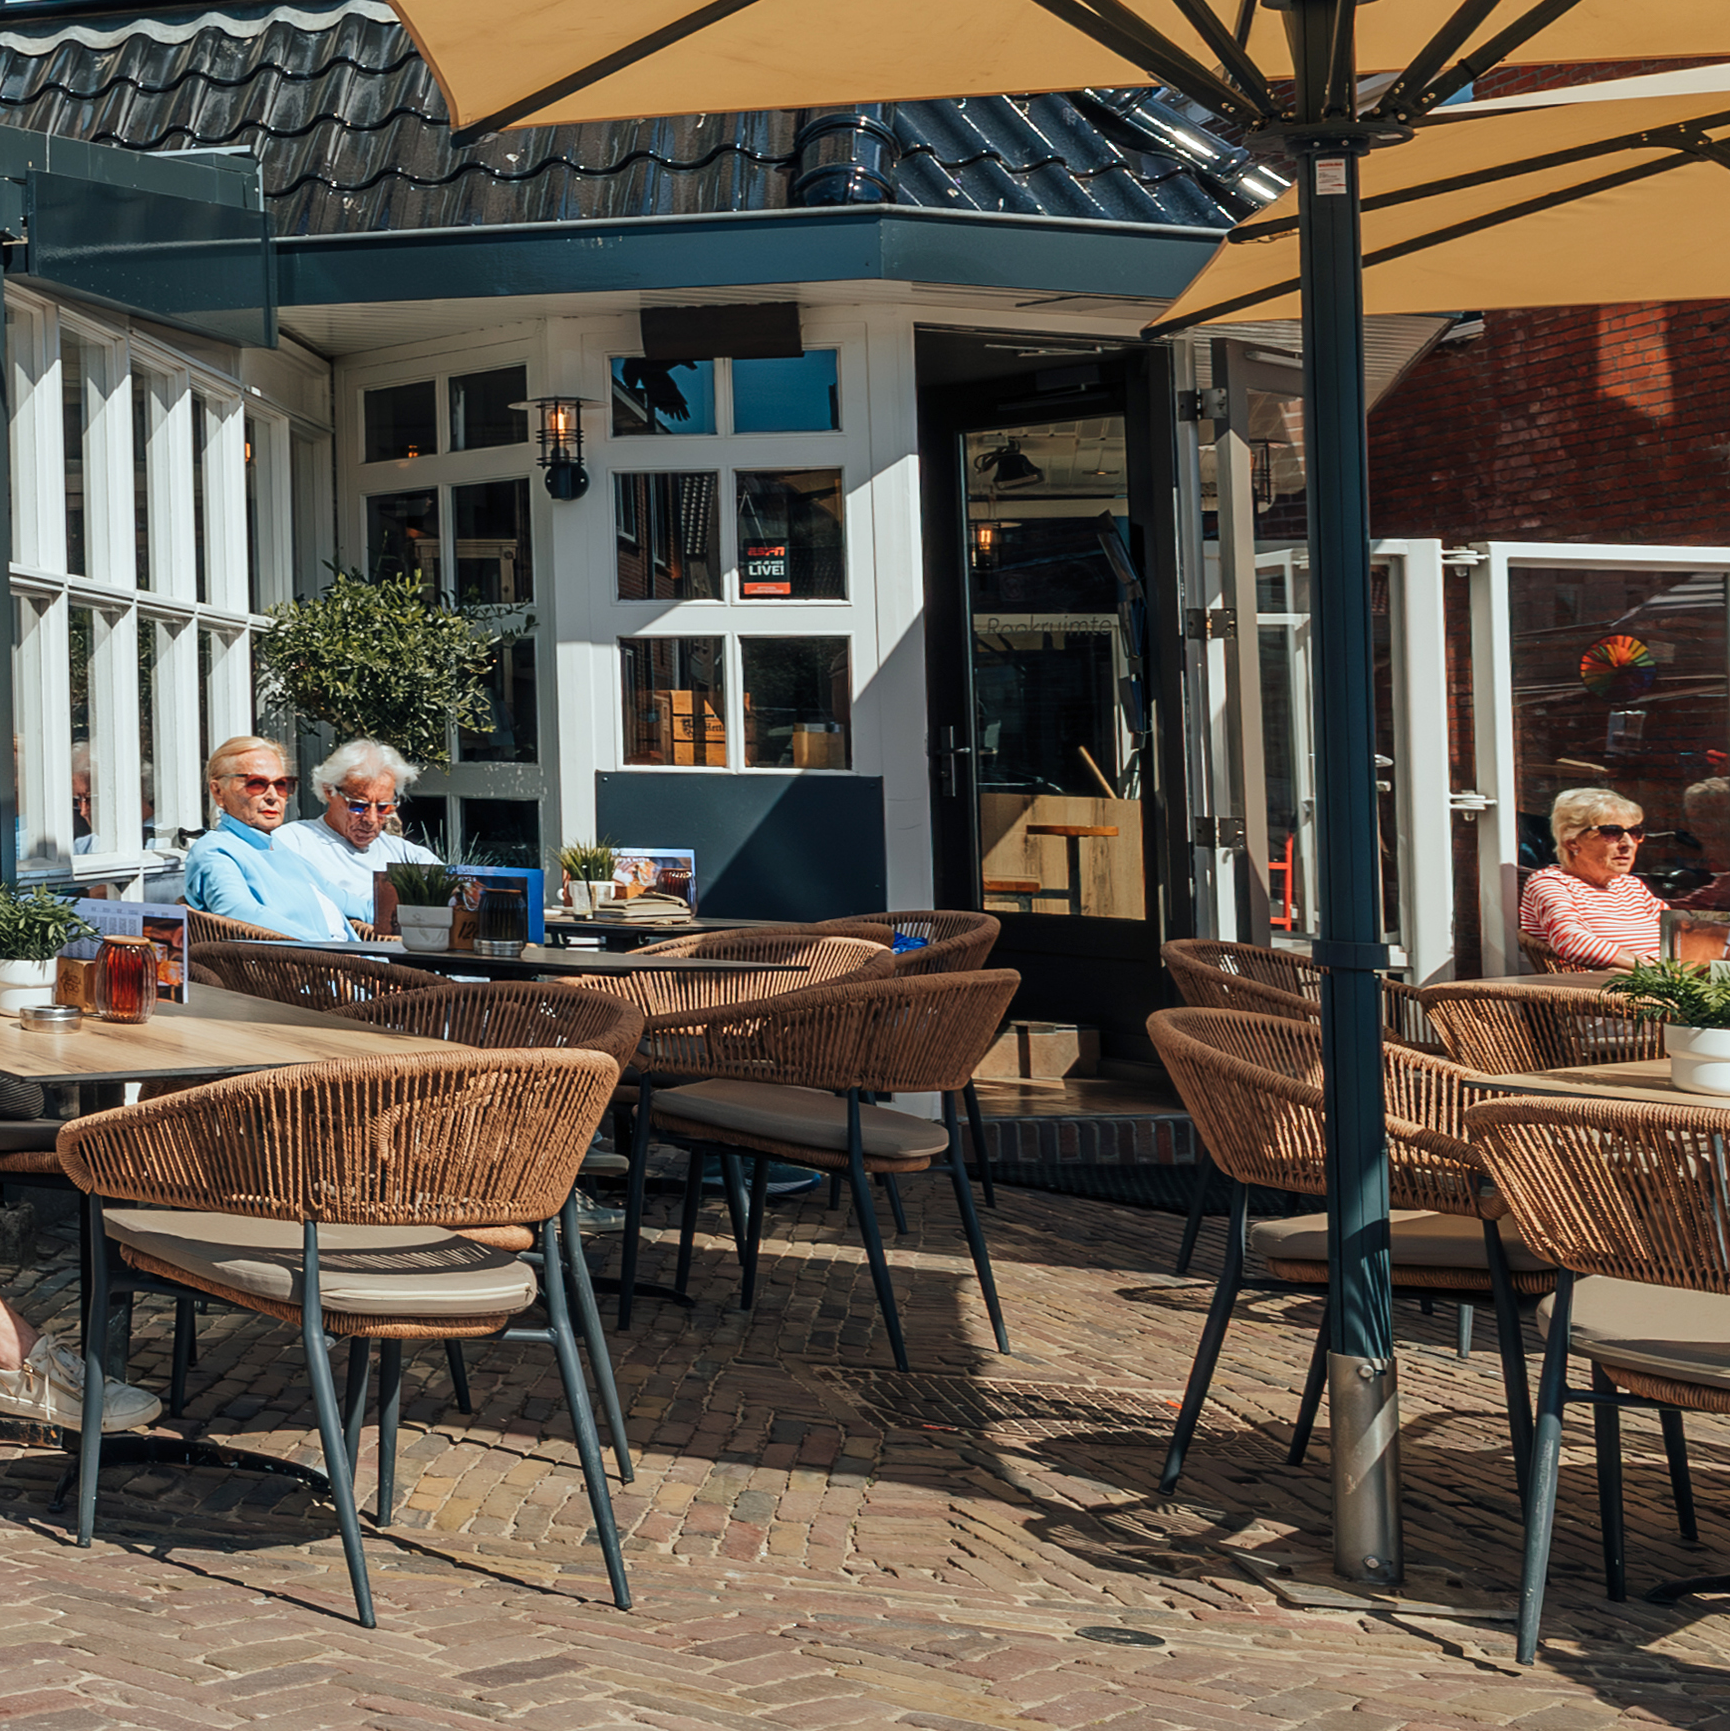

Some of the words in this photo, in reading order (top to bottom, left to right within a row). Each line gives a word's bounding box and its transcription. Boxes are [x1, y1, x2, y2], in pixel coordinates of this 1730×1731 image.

[749, 565, 784, 575] LIVE!
[988, 614, 1112, 636] Rookruimte
[457, 920, 479, 940] 12
